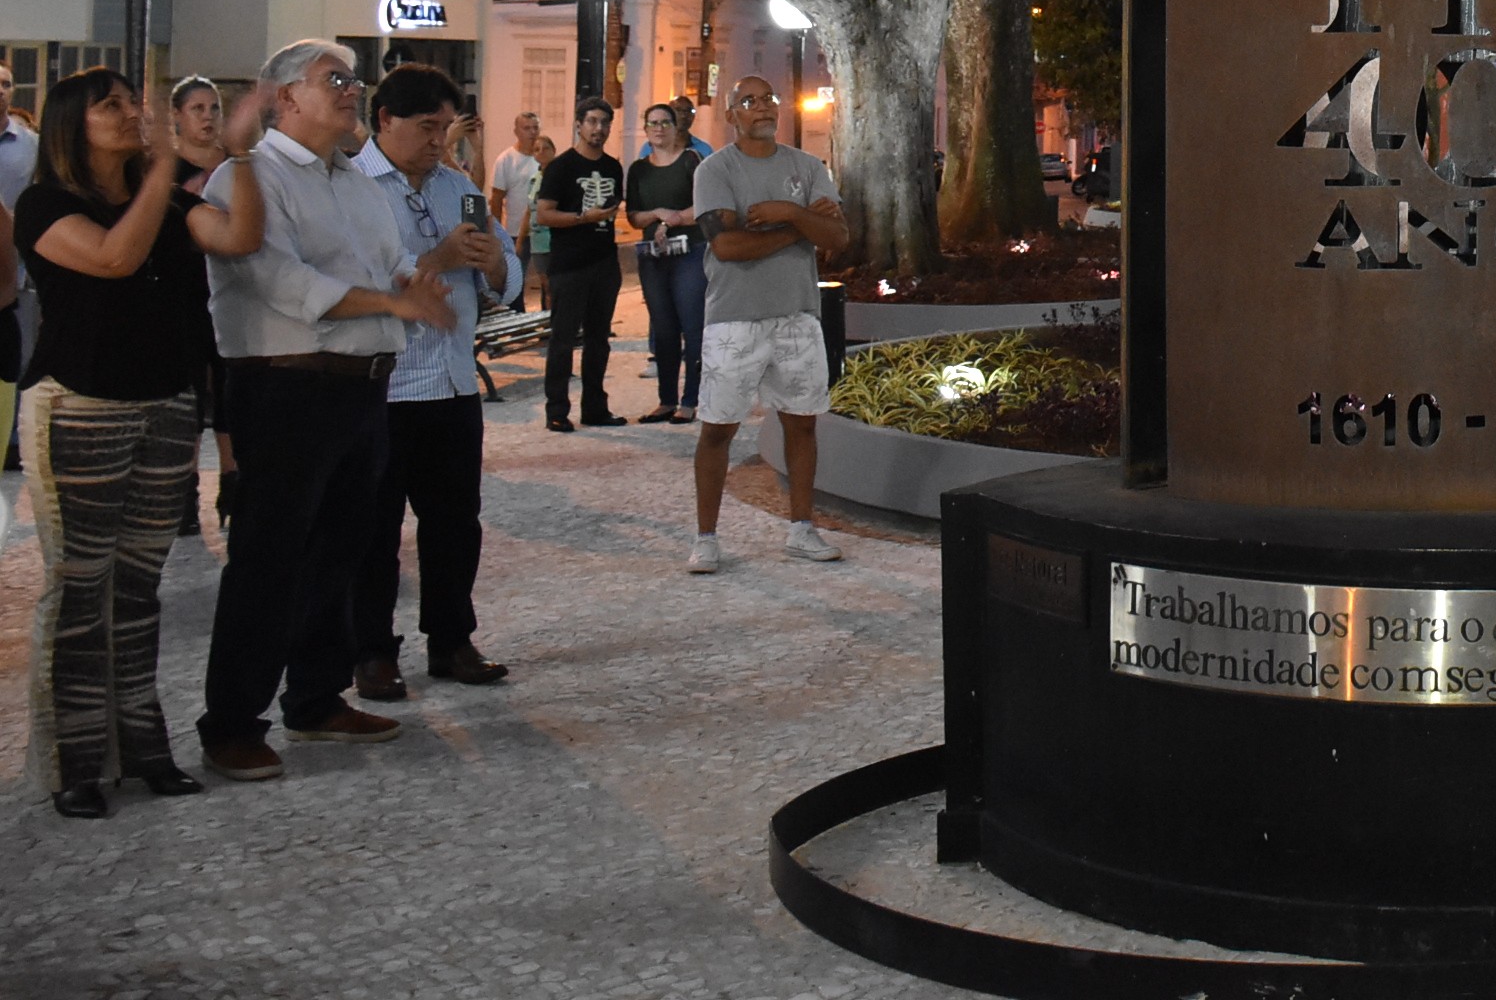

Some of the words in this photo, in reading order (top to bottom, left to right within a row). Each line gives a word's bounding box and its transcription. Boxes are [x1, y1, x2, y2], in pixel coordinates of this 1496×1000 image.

[1297, 391, 1443, 448] 1610
[1366, 609, 1451, 652] para
[1460, 616, 1484, 644] o
[1113, 637, 1340, 690] modernidade
[1350, 663, 1443, 693] com
